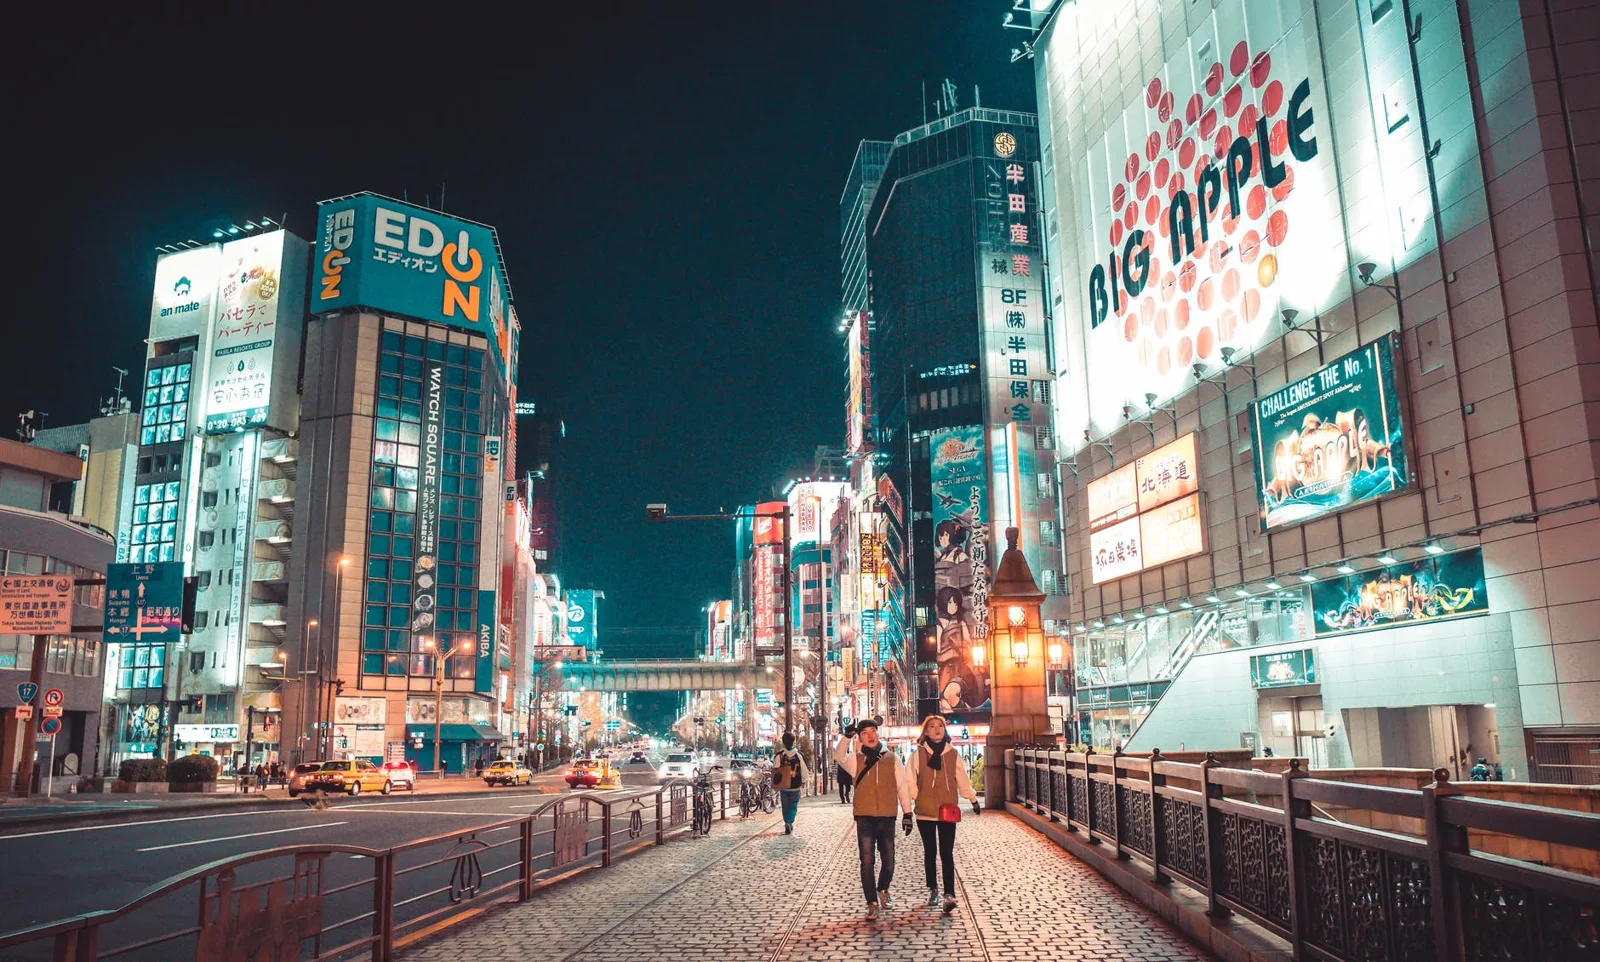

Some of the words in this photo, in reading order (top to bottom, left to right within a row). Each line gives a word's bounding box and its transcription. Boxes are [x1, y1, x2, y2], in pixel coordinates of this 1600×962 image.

[1006, 164, 1030, 277] 半田産業
[1088, 228, 1151, 330] BIG
[1169, 77, 1318, 266] APPLE
[320, 208, 354, 300] EDION
[373, 248, 438, 273] エディオン
[374, 207, 483, 322] EDION
[160, 300, 200, 317] animate
[218, 304, 267, 322] パセラで
[1001, 288, 1027, 305] 8F
[217, 321, 274, 340] パーティー
[429, 367, 442, 422] WATCH
[1261, 377, 1316, 418] CHALLENGE
[1319, 364, 1340, 391] THE
[1344, 357, 1363, 380] No.
[1365, 349, 1373, 369] 1
[424, 424, 438, 485] SQUARE
[949, 466, 966, 474] SEGA
[1141, 460, 1190, 494] 北海道
[131, 564, 155, 574] 上野
[969, 486, 989, 639] ようこそ新たな鎮守府
[108, 607, 129, 617] 本郷
[147, 606, 180, 617] 昭和通り
[480, 624, 490, 658] AKIBA
